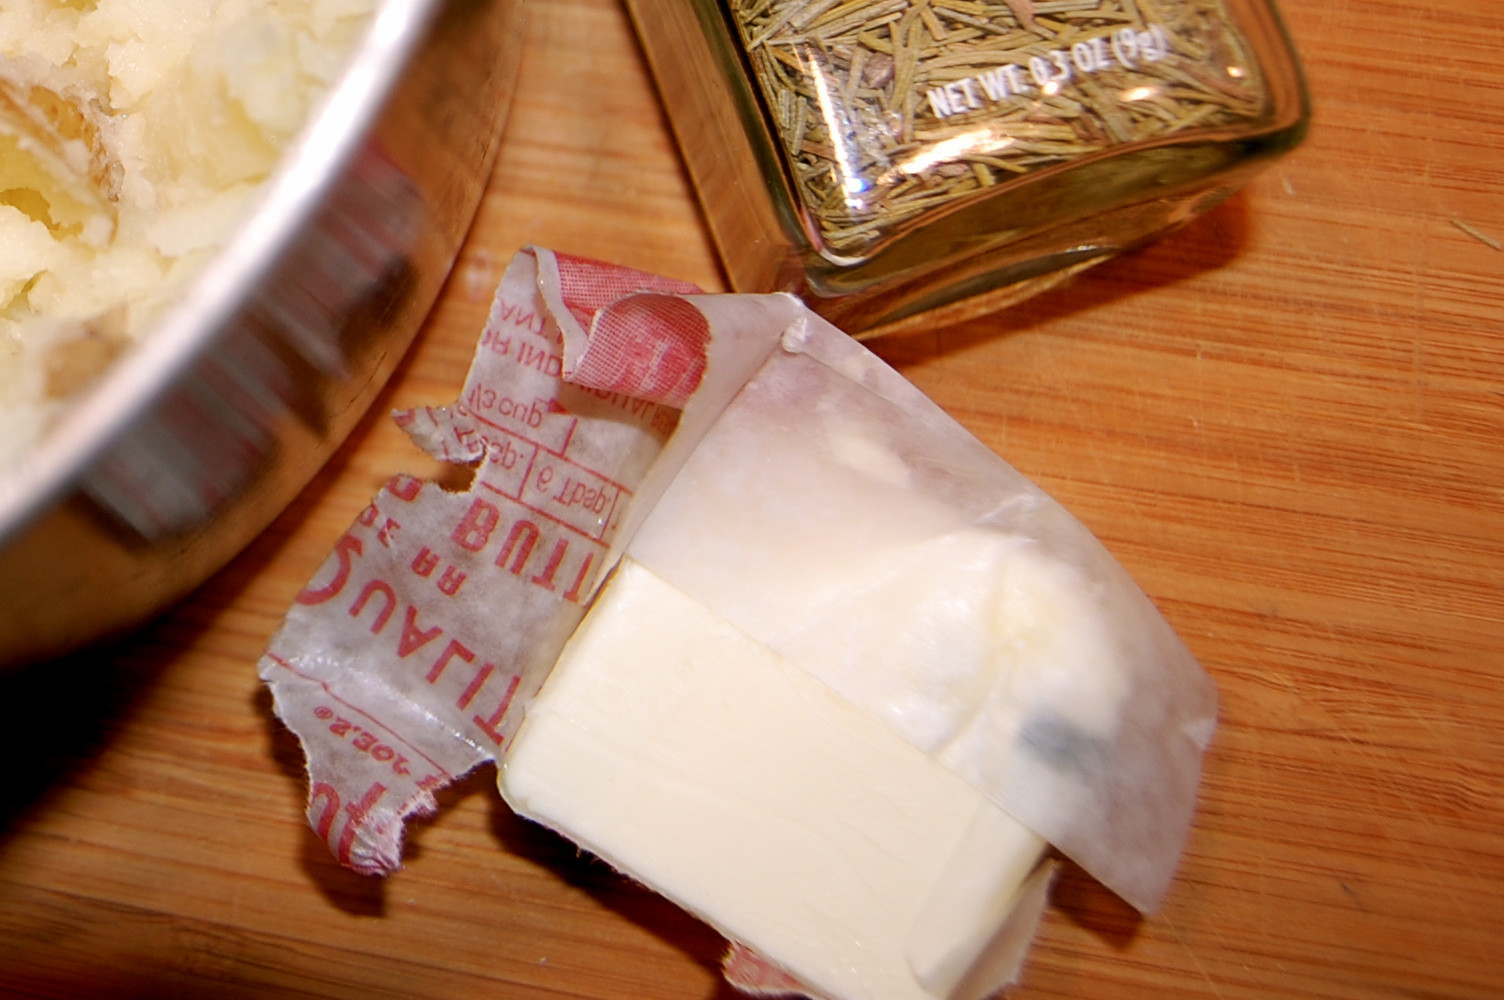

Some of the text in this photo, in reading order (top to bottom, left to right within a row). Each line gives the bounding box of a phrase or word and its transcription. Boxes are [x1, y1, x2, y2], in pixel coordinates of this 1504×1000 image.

[926, 77, 982, 119] NET
[1027, 49, 1073, 89] 03
[1071, 35, 1113, 73] OZ
